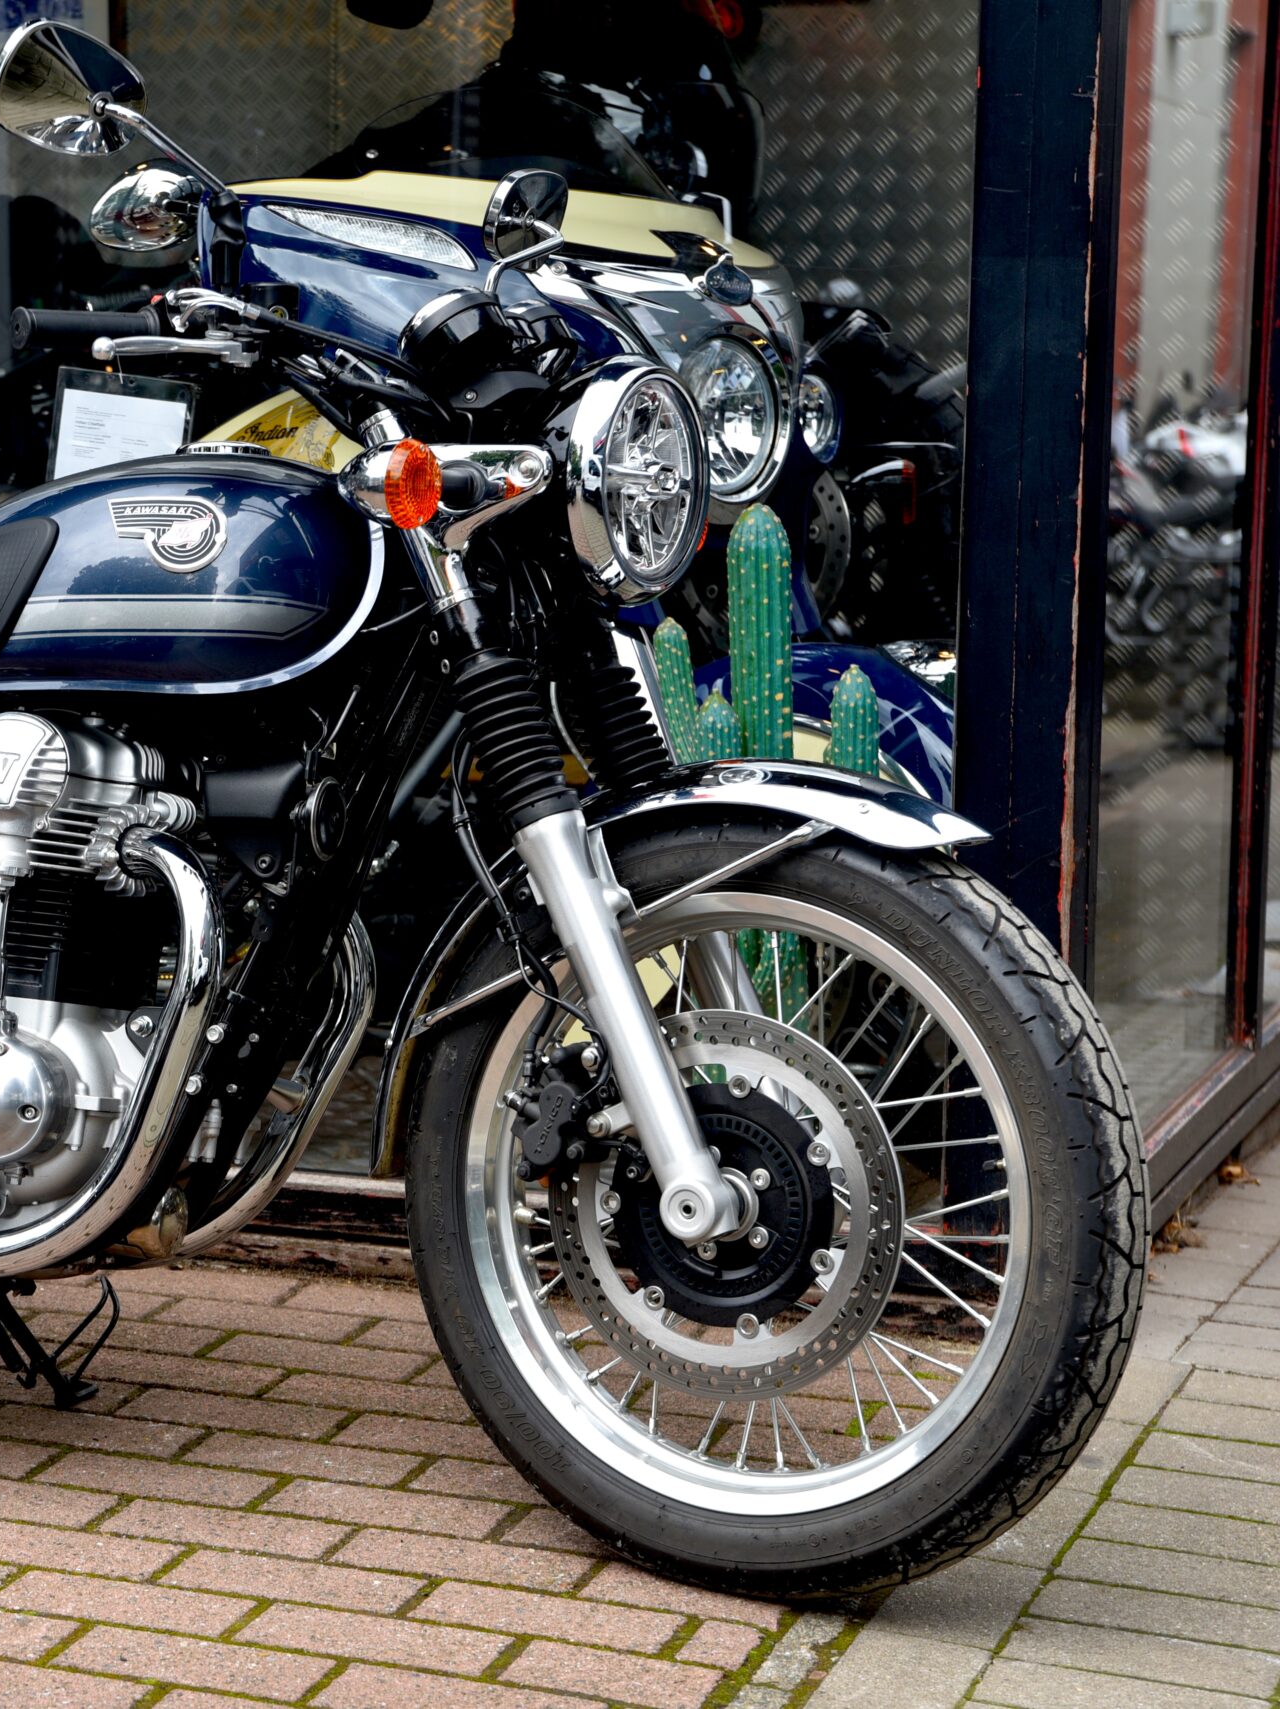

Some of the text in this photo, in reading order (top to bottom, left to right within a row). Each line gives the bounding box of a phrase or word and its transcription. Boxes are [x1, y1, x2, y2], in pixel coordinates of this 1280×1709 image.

[236, 421, 299, 443] Indian
[124, 506, 193, 515] KAWASAKI
[882, 910, 1012, 1037] DUNLOP
[534, 1095, 564, 1154] TOKICO
